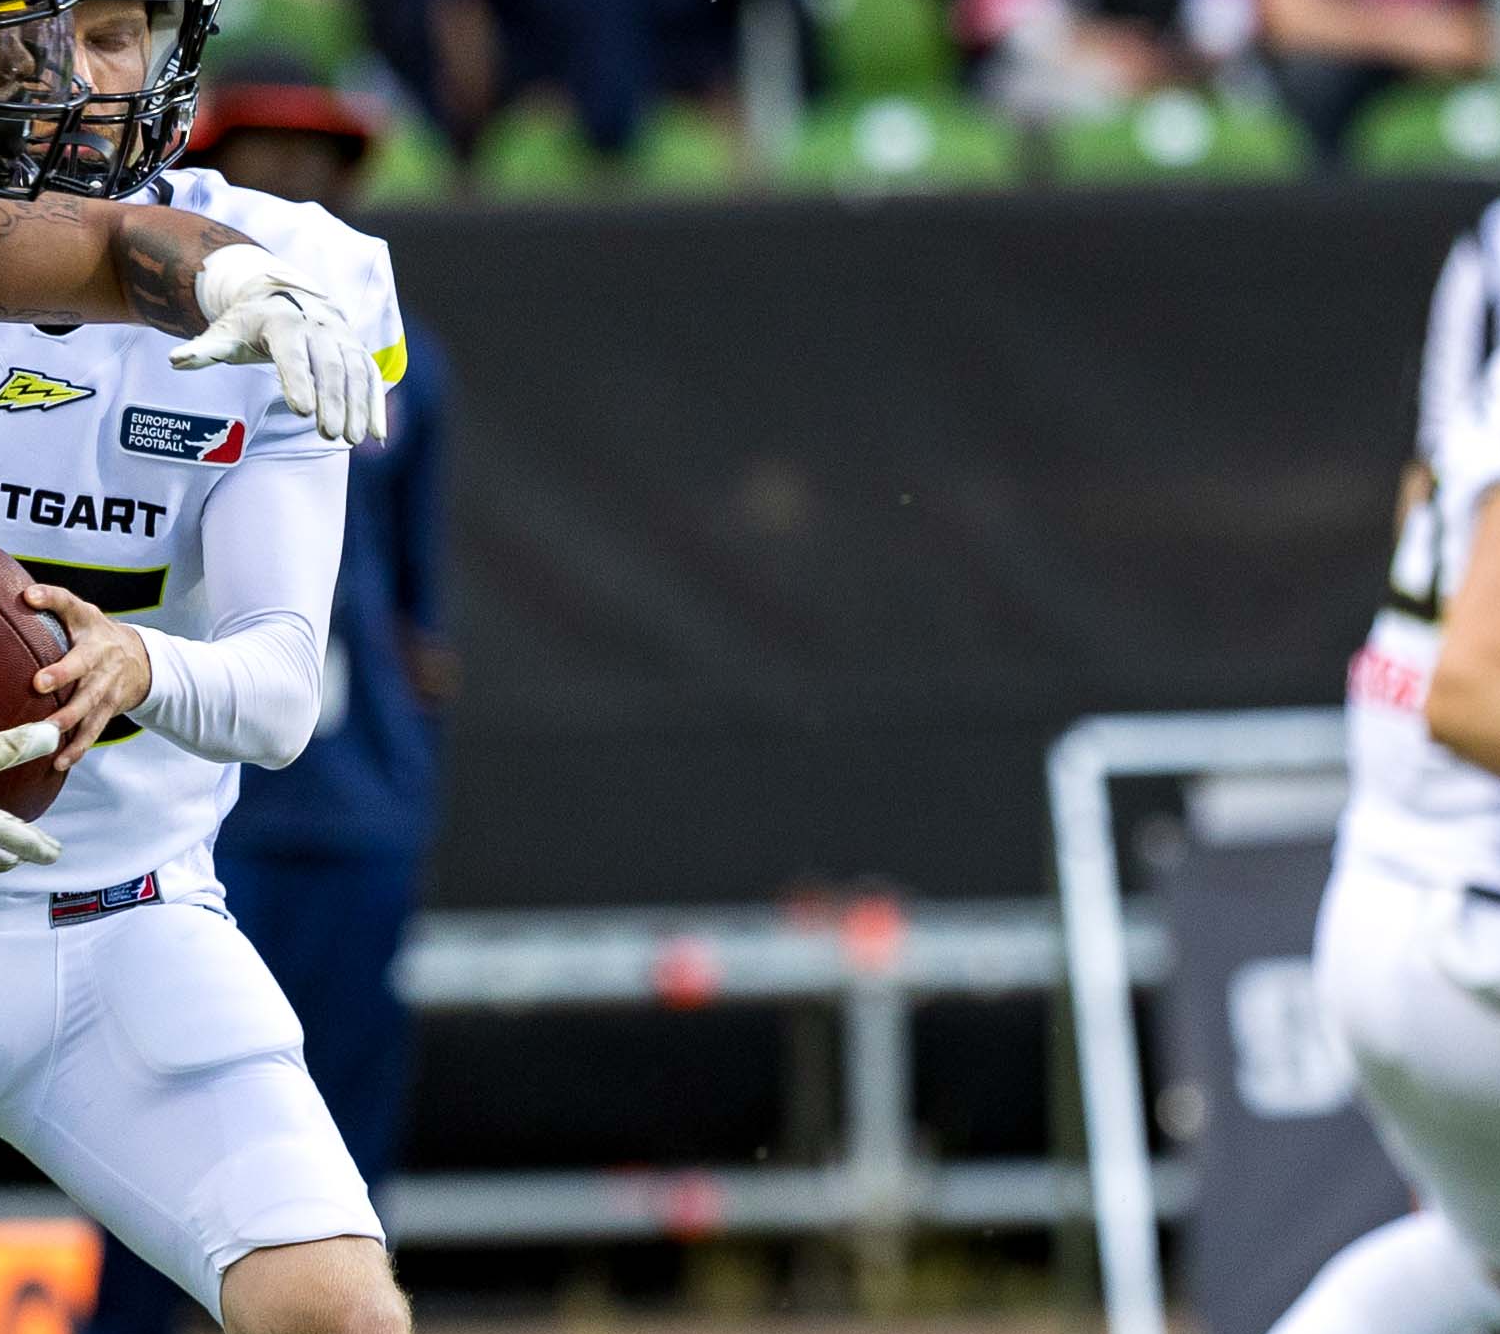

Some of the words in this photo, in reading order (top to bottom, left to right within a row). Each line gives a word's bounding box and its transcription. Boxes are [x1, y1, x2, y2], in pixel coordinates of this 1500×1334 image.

[131, 412, 191, 432] EUROPEAN
[130, 424, 172, 440] LEAGUE
[128, 435, 185, 453] FOOTBALL
